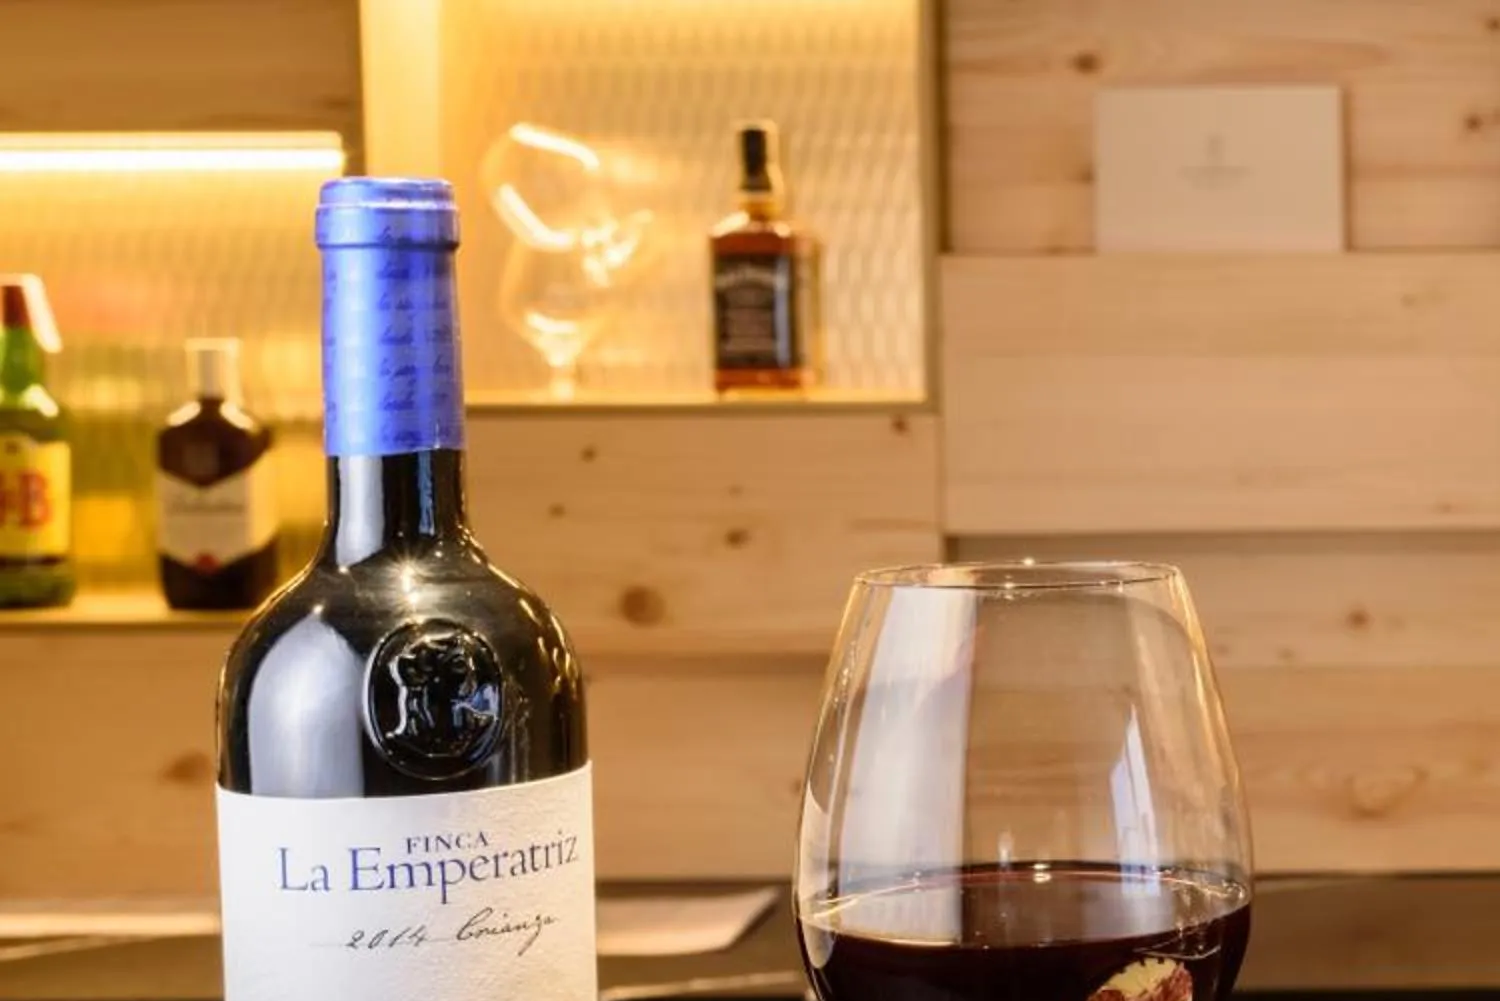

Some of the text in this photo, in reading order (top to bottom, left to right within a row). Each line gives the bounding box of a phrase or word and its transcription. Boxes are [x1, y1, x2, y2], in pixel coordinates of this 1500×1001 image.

[279, 830, 579, 905] La Emperatriz
[406, 831, 489, 854] FINCA
[345, 906, 558, 957] 2014 Crianza
